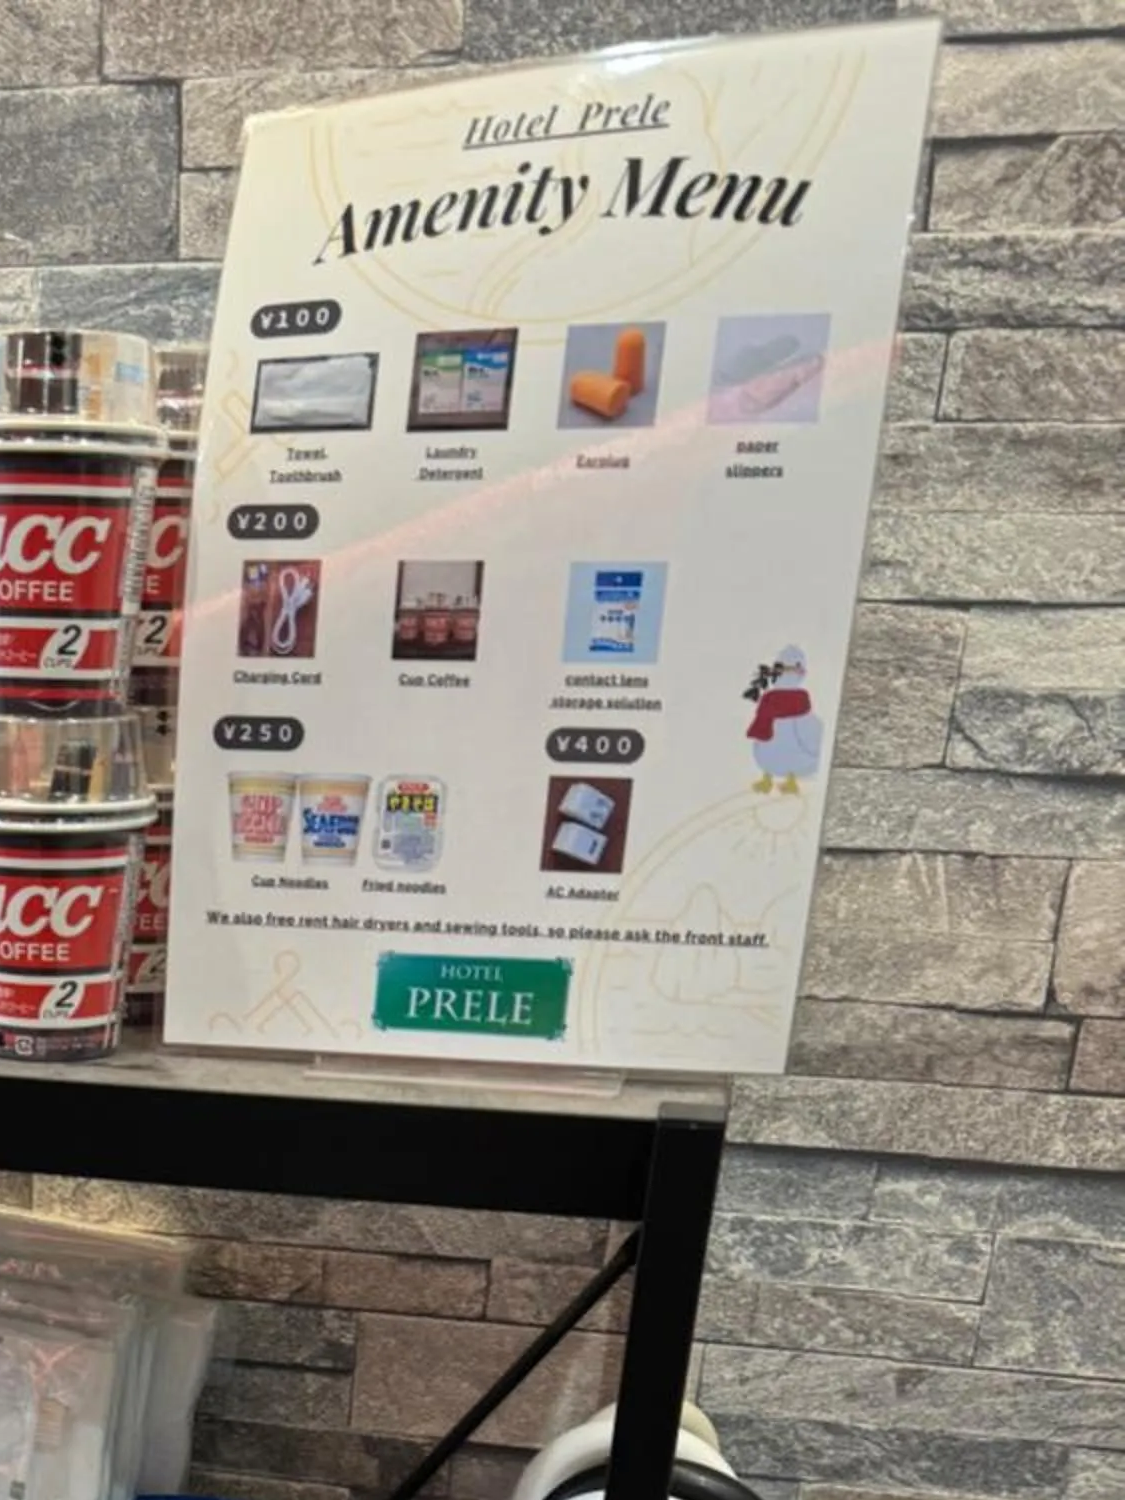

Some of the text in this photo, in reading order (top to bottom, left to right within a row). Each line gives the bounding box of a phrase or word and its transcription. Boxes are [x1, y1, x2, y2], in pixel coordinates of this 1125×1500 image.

[465, 105, 557, 147] Hotel
[312, 155, 812, 265] Amenity Menu
[259, 306, 331, 331] ¥100
[425, 446, 478, 460] Laundry
[237, 511, 308, 531] ¥200
[58, 624, 82, 656] 2
[144, 615, 167, 645] 2
[427, 673, 470, 688] Coffee
[564, 673, 617, 688] contact
[223, 723, 293, 742] ¥250
[556, 735, 632, 755] ¥400
[251, 874, 329, 890] Cup Noodles
[362, 879, 447, 895] Fried noodles
[546, 886, 620, 901] AC Adapter
[206, 911, 229, 925] We
[232, 911, 263, 926] also
[266, 912, 295, 927] free
[298, 914, 329, 928] rent
[331, 915, 360, 930] hair
[362, 916, 410, 933] dryers
[413, 918, 441, 932] and
[445, 922, 497, 938] sewing
[547, 926, 565, 939] so
[568, 926, 620, 942] please
[624, 928, 650, 942] ask
[654, 928, 682, 944] the
[683, 929, 724, 945] front
[440, 963, 503, 982] HOTEL
[55, 980, 79, 1009] 2
[406, 986, 534, 1026] PRELE
